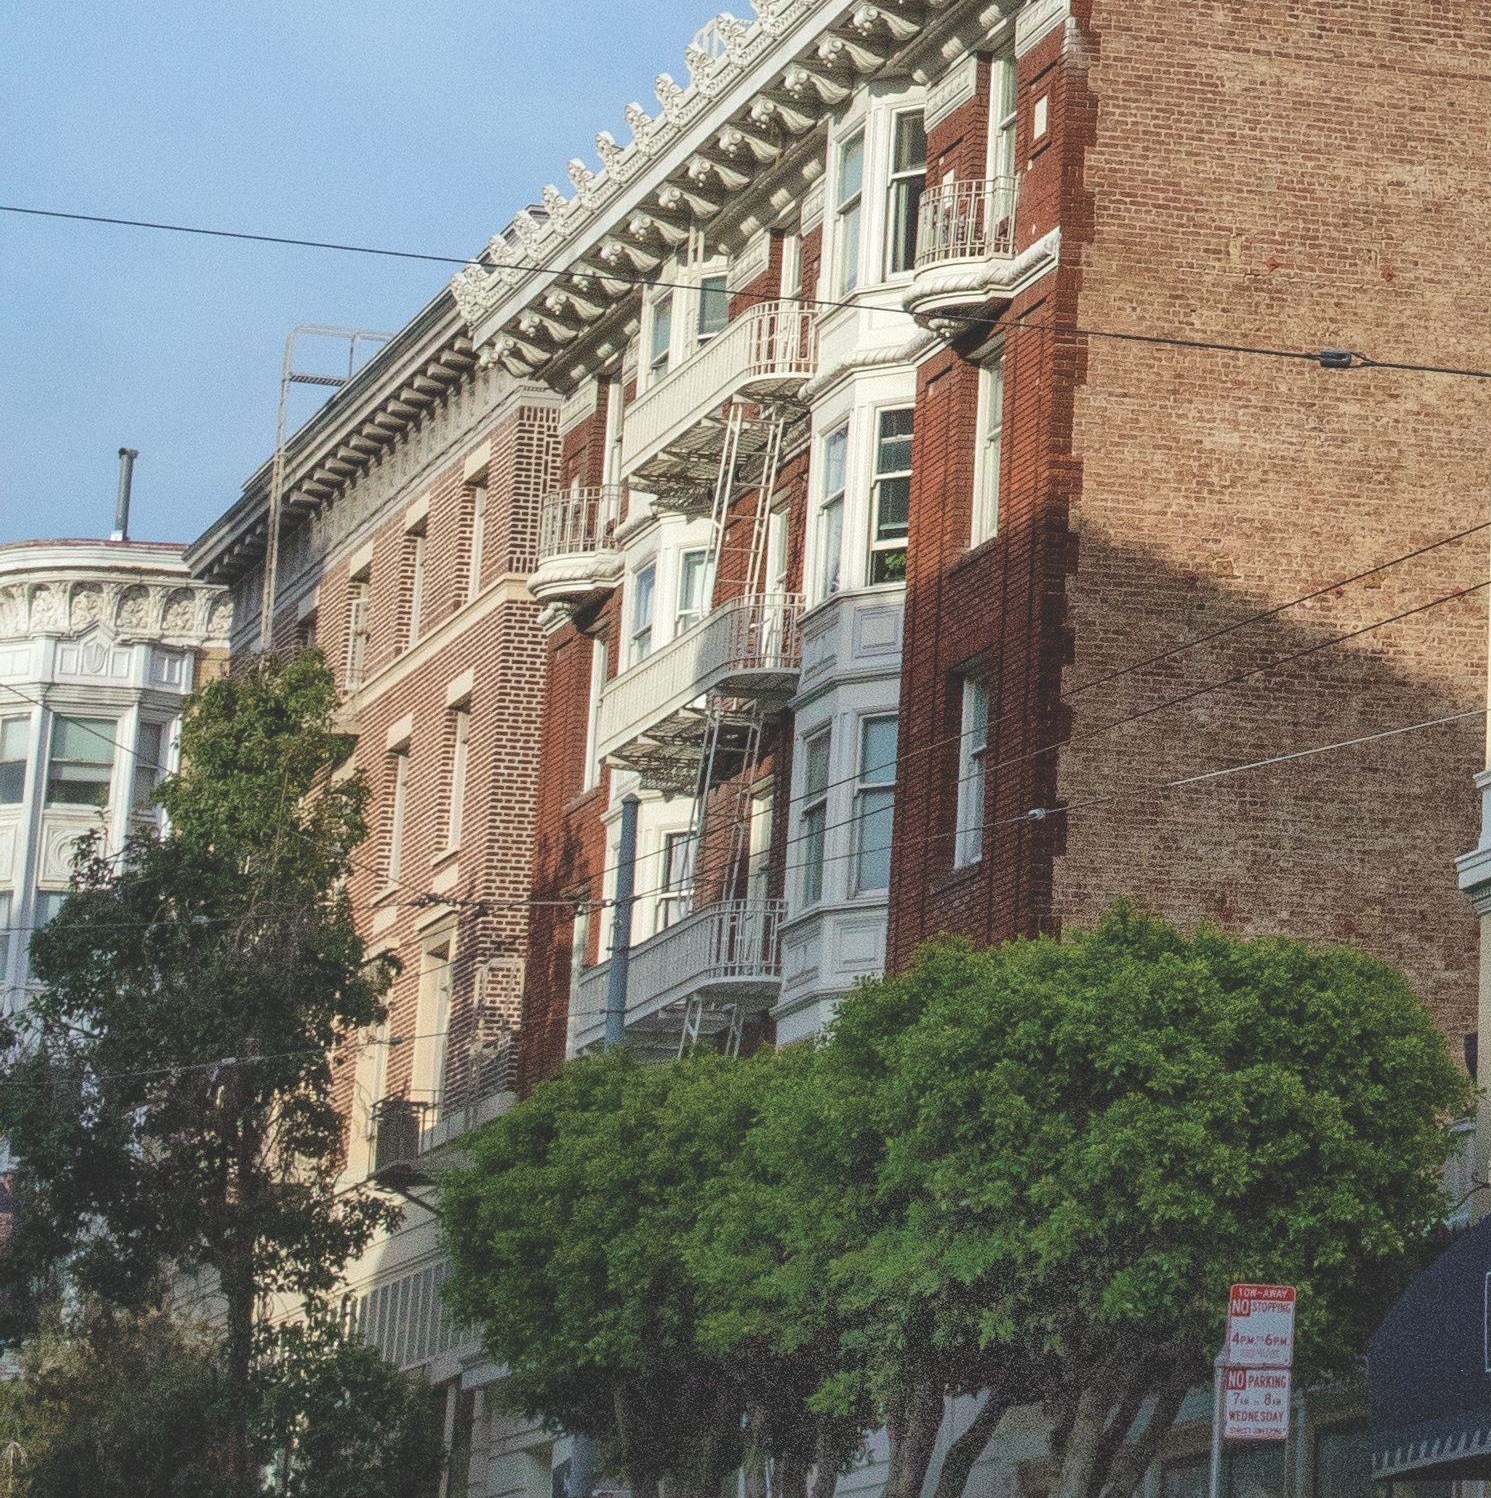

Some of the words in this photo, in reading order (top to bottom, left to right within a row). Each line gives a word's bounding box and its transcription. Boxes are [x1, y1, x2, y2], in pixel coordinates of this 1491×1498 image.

[1239, 1287, 1289, 1298] TOW-AWAY
[1232, 1299, 1249, 1314] NO
[1252, 1302, 1291, 1313] STOPPING
[1229, 1370, 1244, 1388] NO
[1248, 1375, 1286, 1388] PARKING
[1229, 1411, 1284, 1422] WEDNESDAY
